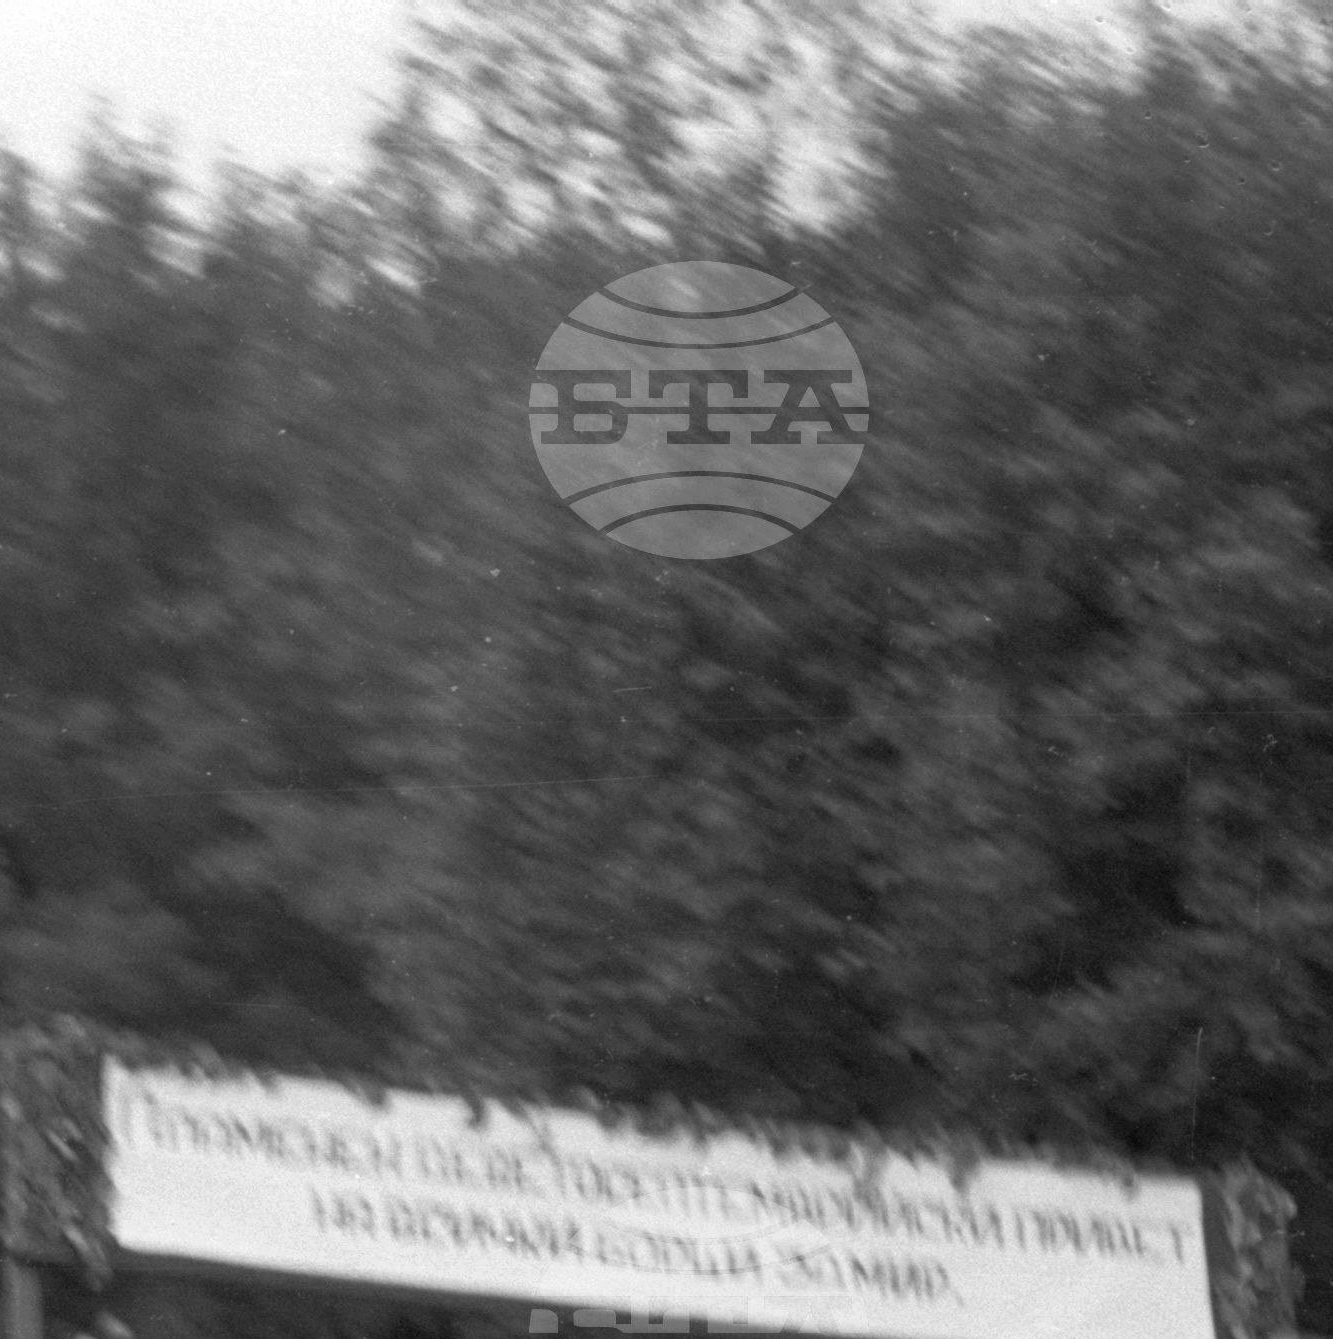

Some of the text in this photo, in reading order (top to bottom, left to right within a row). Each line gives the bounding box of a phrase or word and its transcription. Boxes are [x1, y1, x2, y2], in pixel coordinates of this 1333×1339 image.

[309, 1186, 376, 1238] НА
[596, 1226, 764, 1284] БОРЦИ
[775, 1243, 847, 1291] ЗА
[989, 1203, 1194, 1267] ПРИВЕТ
